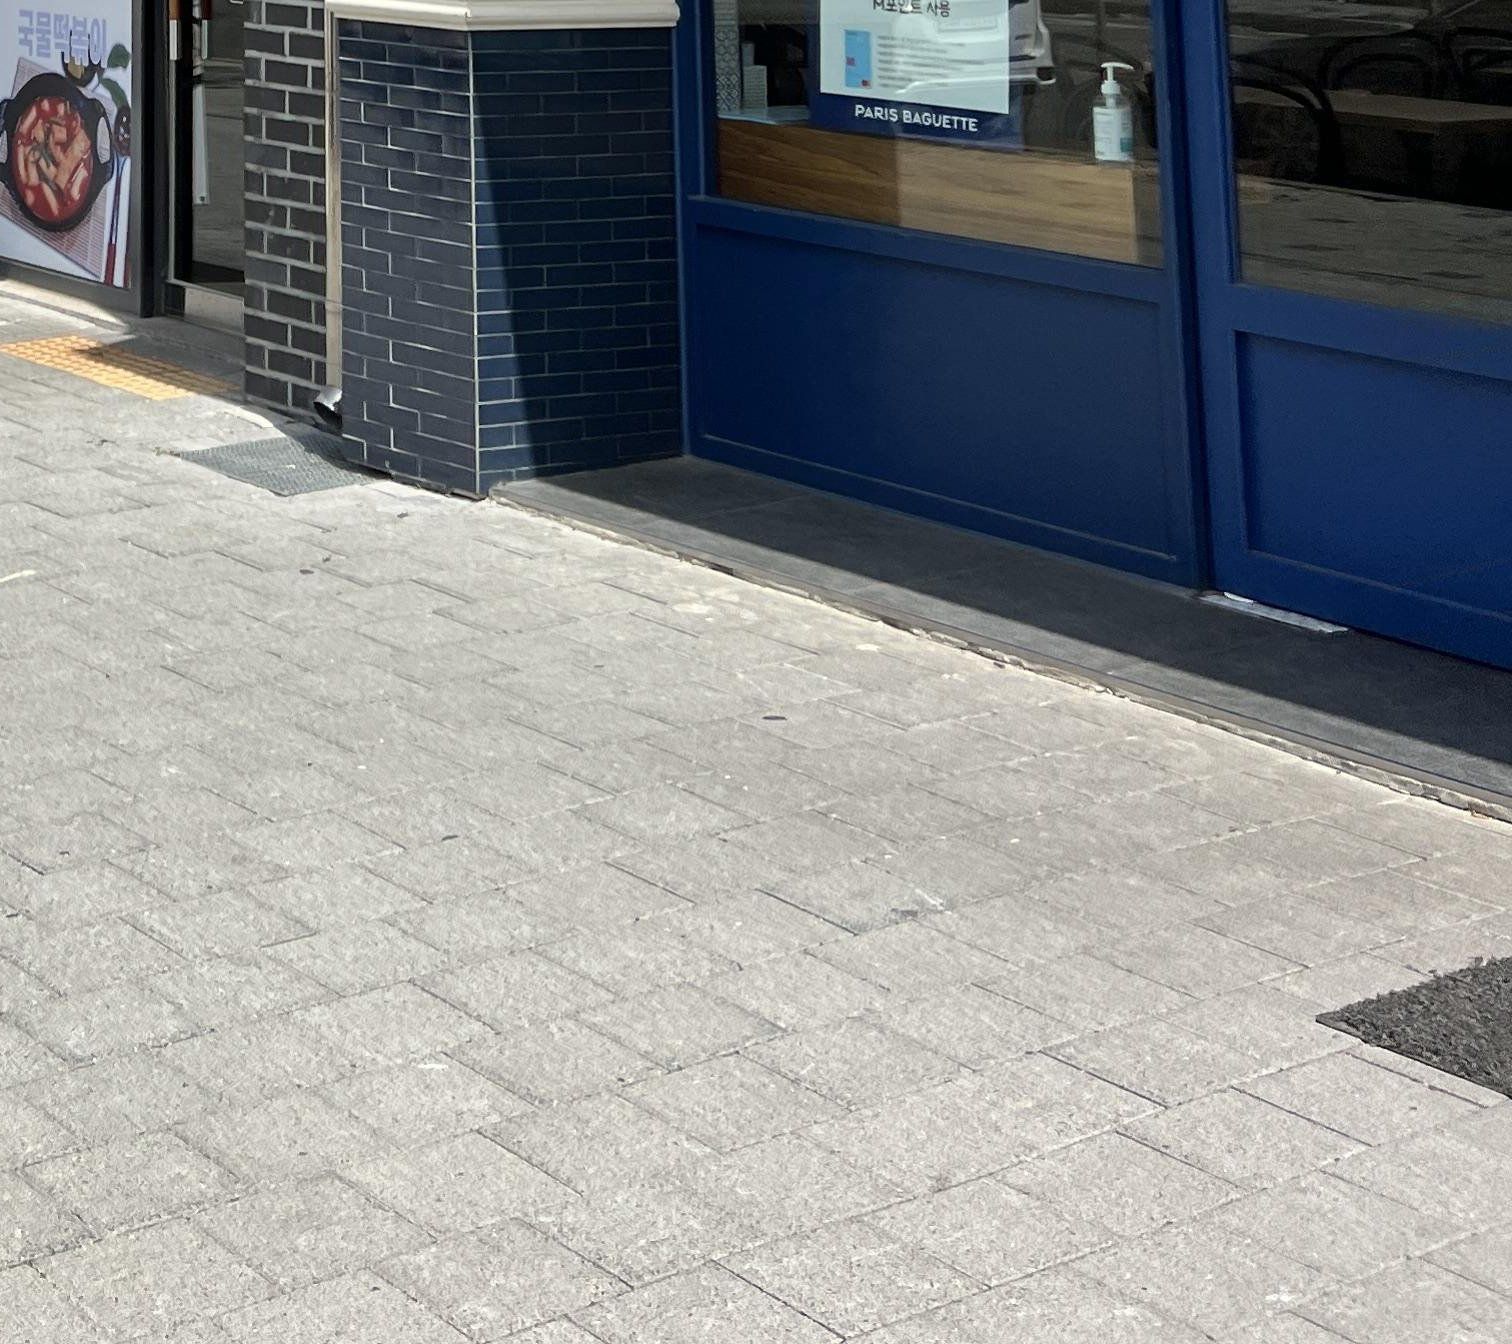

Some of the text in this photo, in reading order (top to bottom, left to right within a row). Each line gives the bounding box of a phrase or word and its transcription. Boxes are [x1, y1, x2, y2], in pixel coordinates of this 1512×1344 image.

[927, 0, 951, 17] 사용
[18, 8, 107, 68] 국물떡볶이
[855, 104, 978, 131] PARIS BAGUETTE
